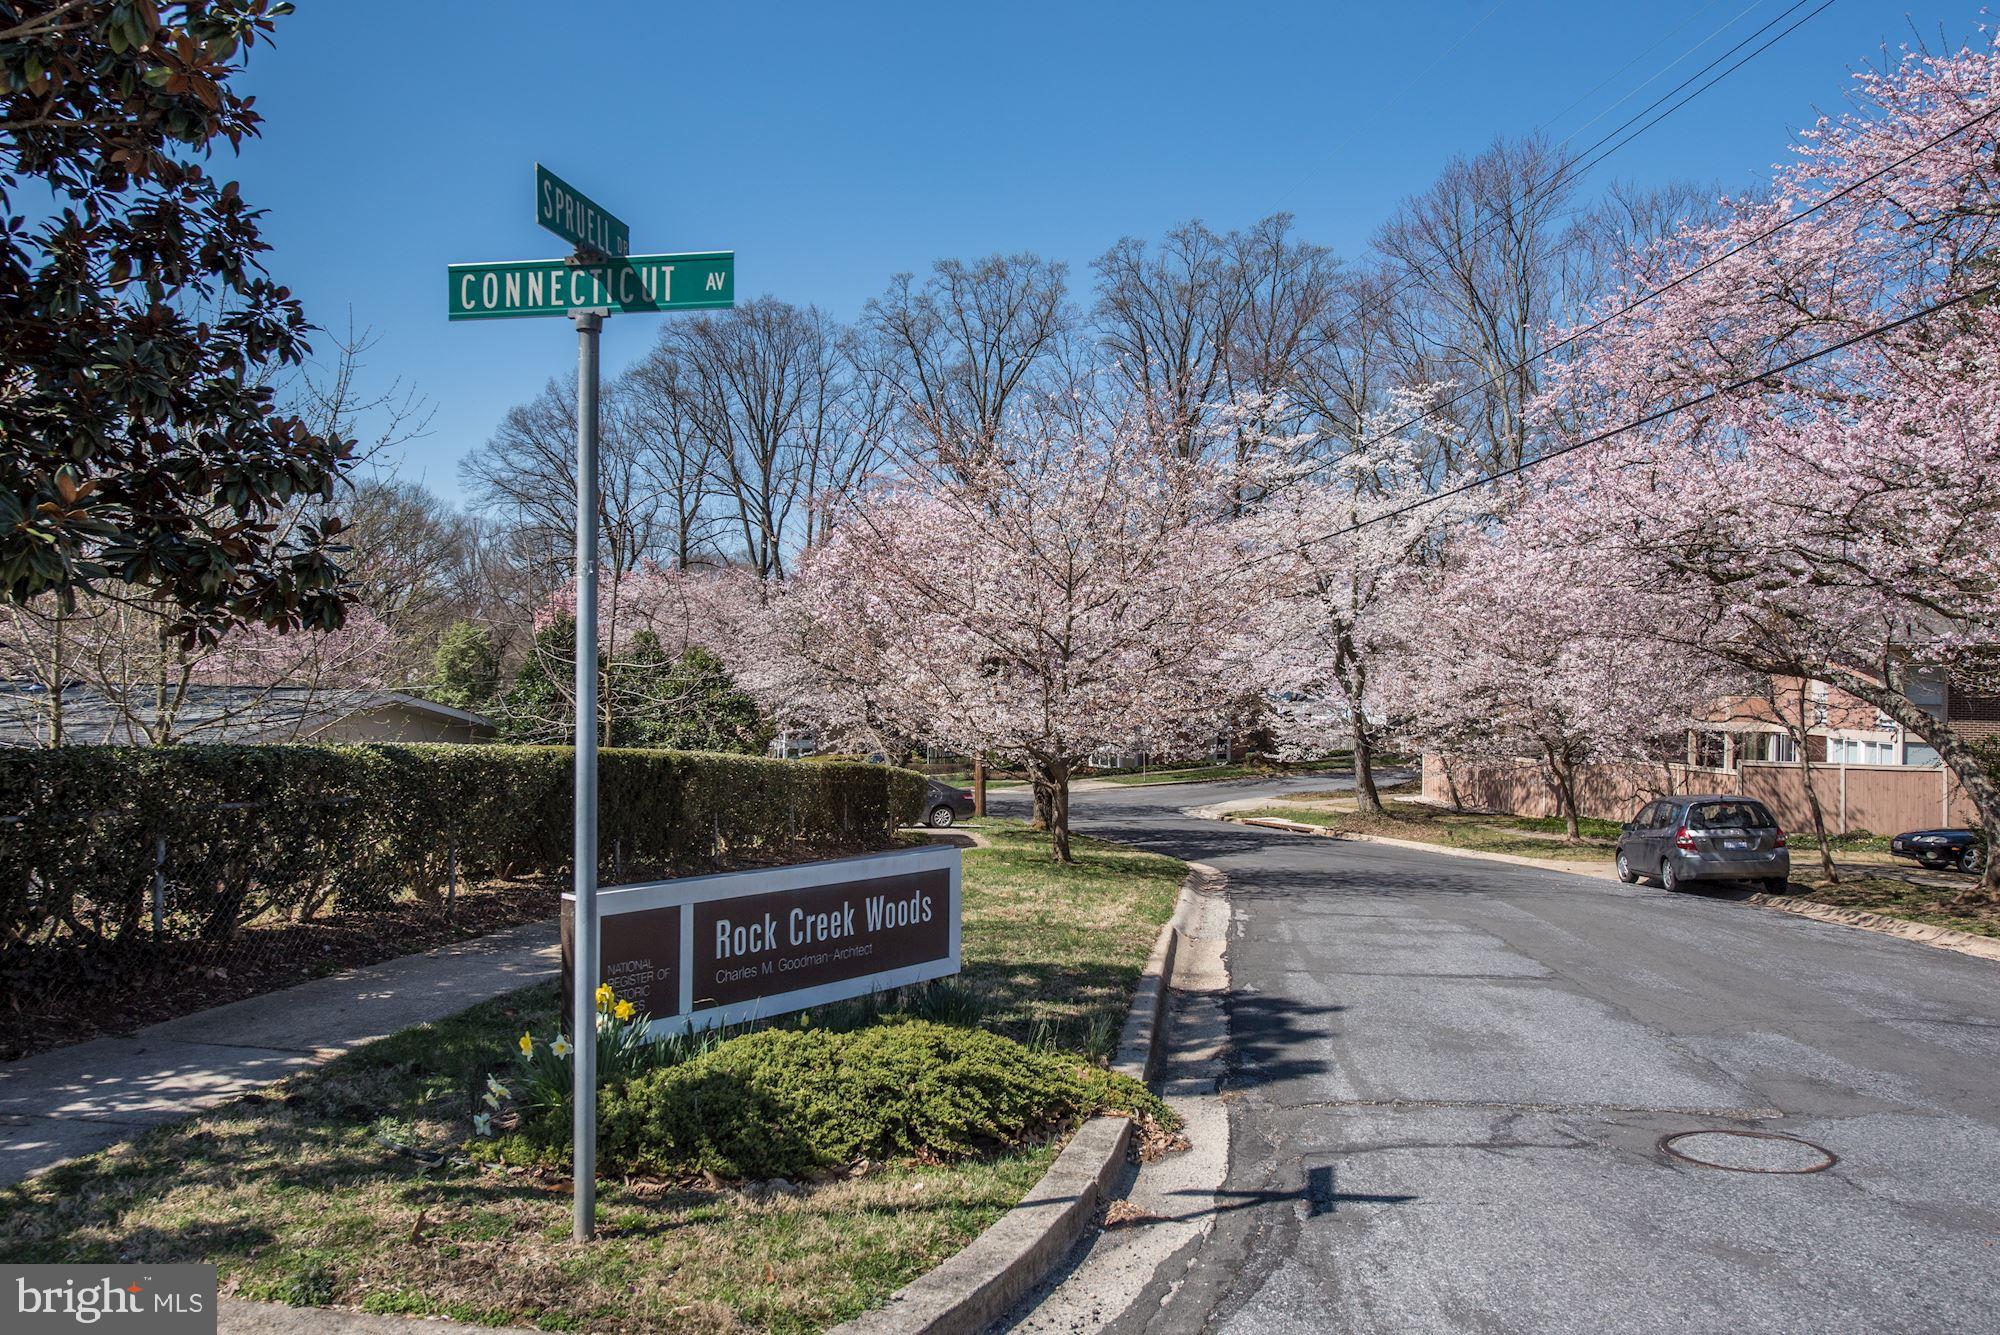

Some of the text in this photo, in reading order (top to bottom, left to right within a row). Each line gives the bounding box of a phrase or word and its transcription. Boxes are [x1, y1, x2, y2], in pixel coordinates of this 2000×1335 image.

[543, 178, 629, 256] SPRUELL DR
[461, 265, 726, 310] CONNECTICUT AV
[715, 890, 932, 960] Rock Creek Woods
[607, 959, 654, 976] NATIONAL
[607, 967, 671, 988] REGISTER OF
[715, 965, 757, 984] Charles
[761, 961, 774, 974] M.
[611, 985, 651, 1001] STORIC
